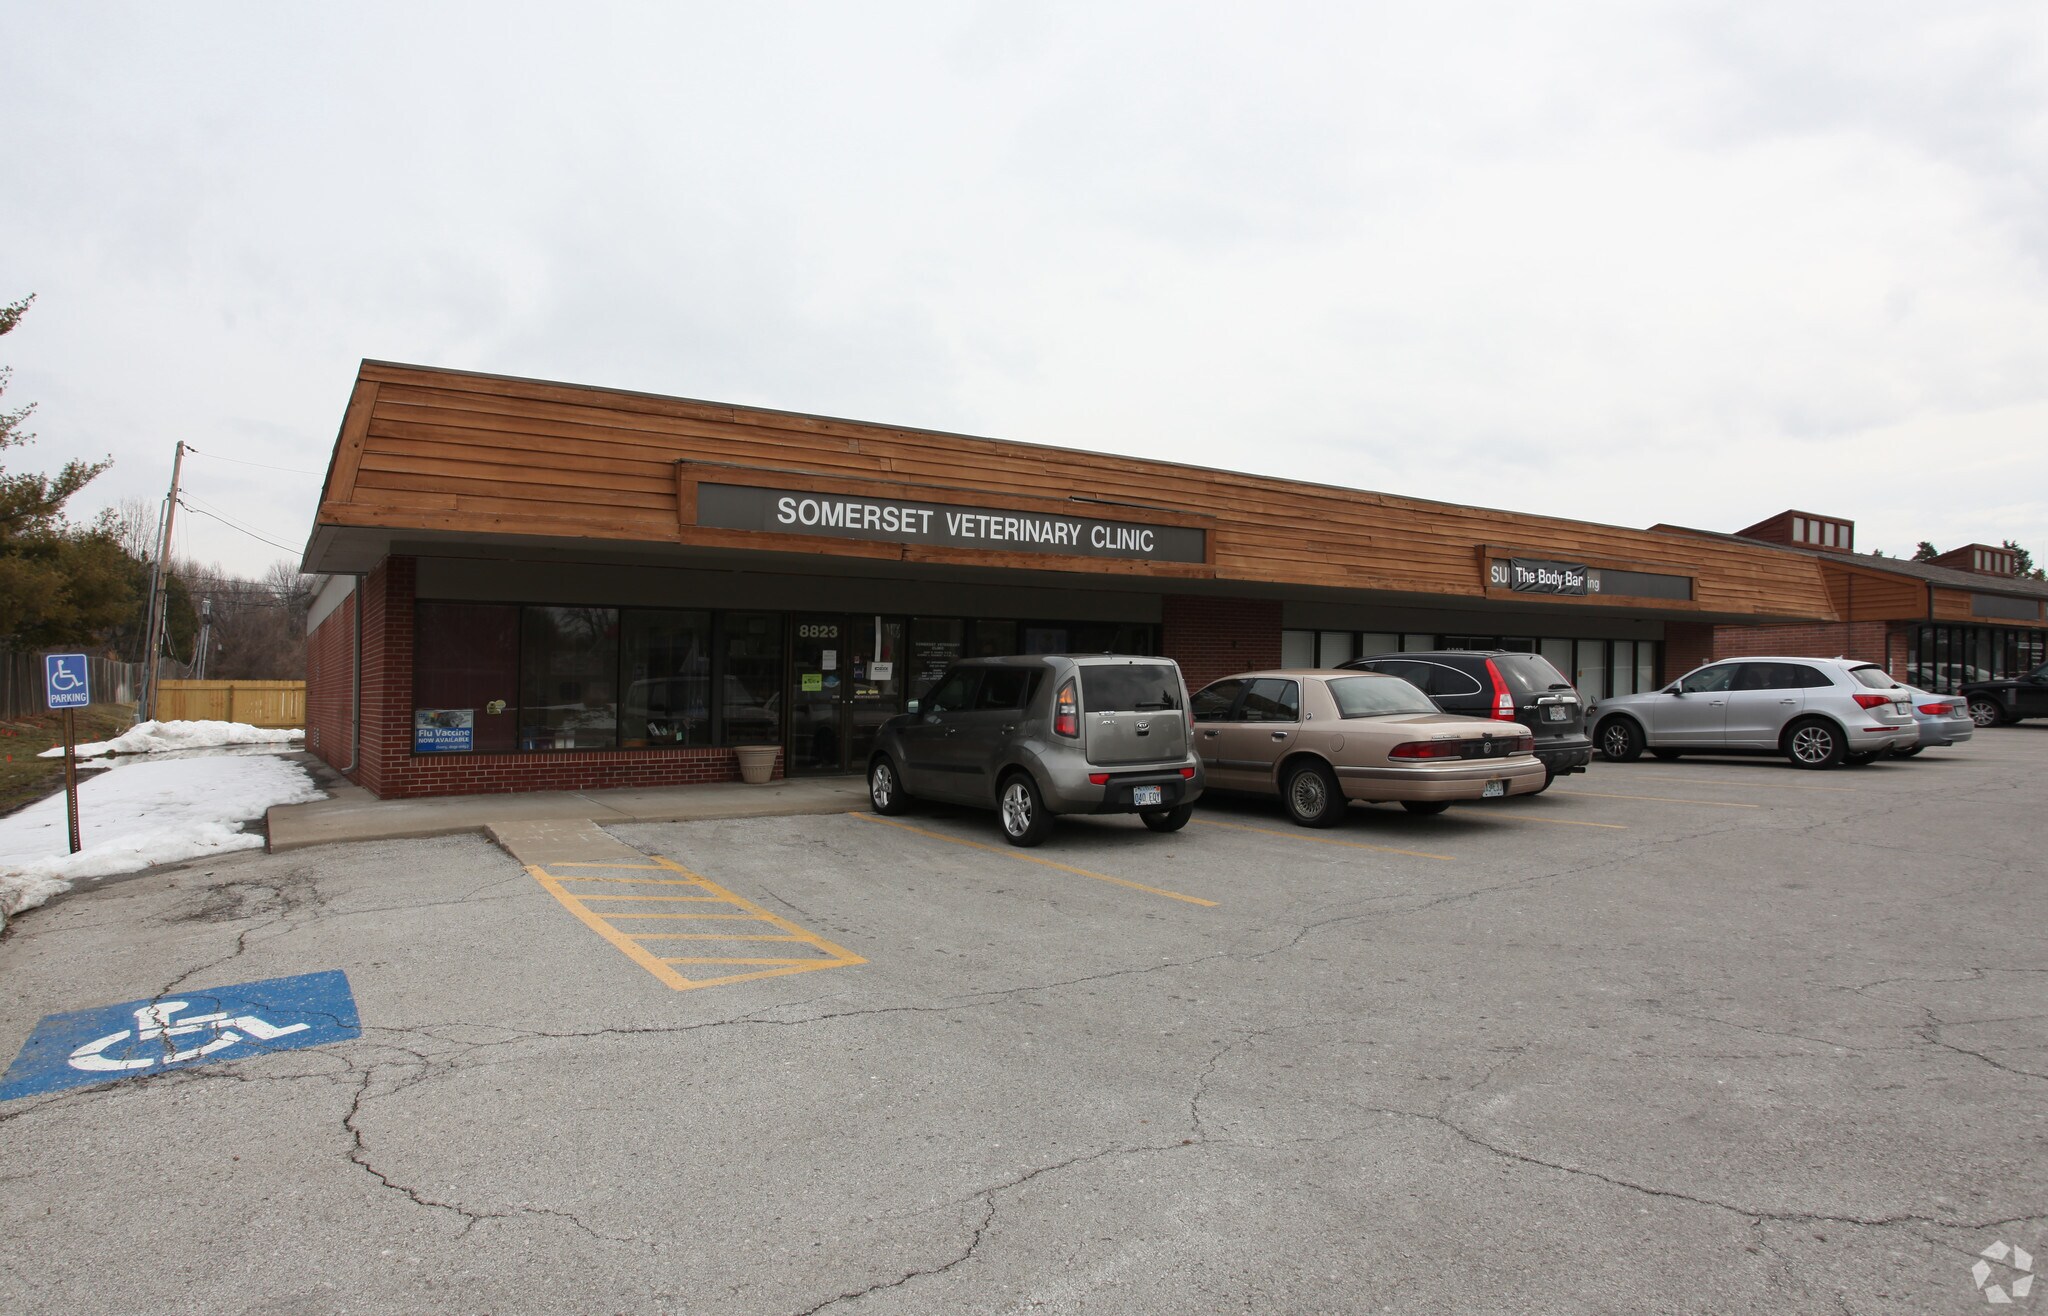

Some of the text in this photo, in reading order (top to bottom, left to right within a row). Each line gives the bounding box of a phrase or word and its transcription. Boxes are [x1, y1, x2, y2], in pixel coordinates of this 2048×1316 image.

[776, 497, 1154, 552] SOMERSET VETERINARY CLINIC
[1491, 565, 1511, 583] SU
[1516, 567, 1584, 589] The Body Bar
[800, 625, 838, 638] 8823
[51, 693, 87, 703] PARKING
[418, 729, 470, 737] Flu Vaccine
